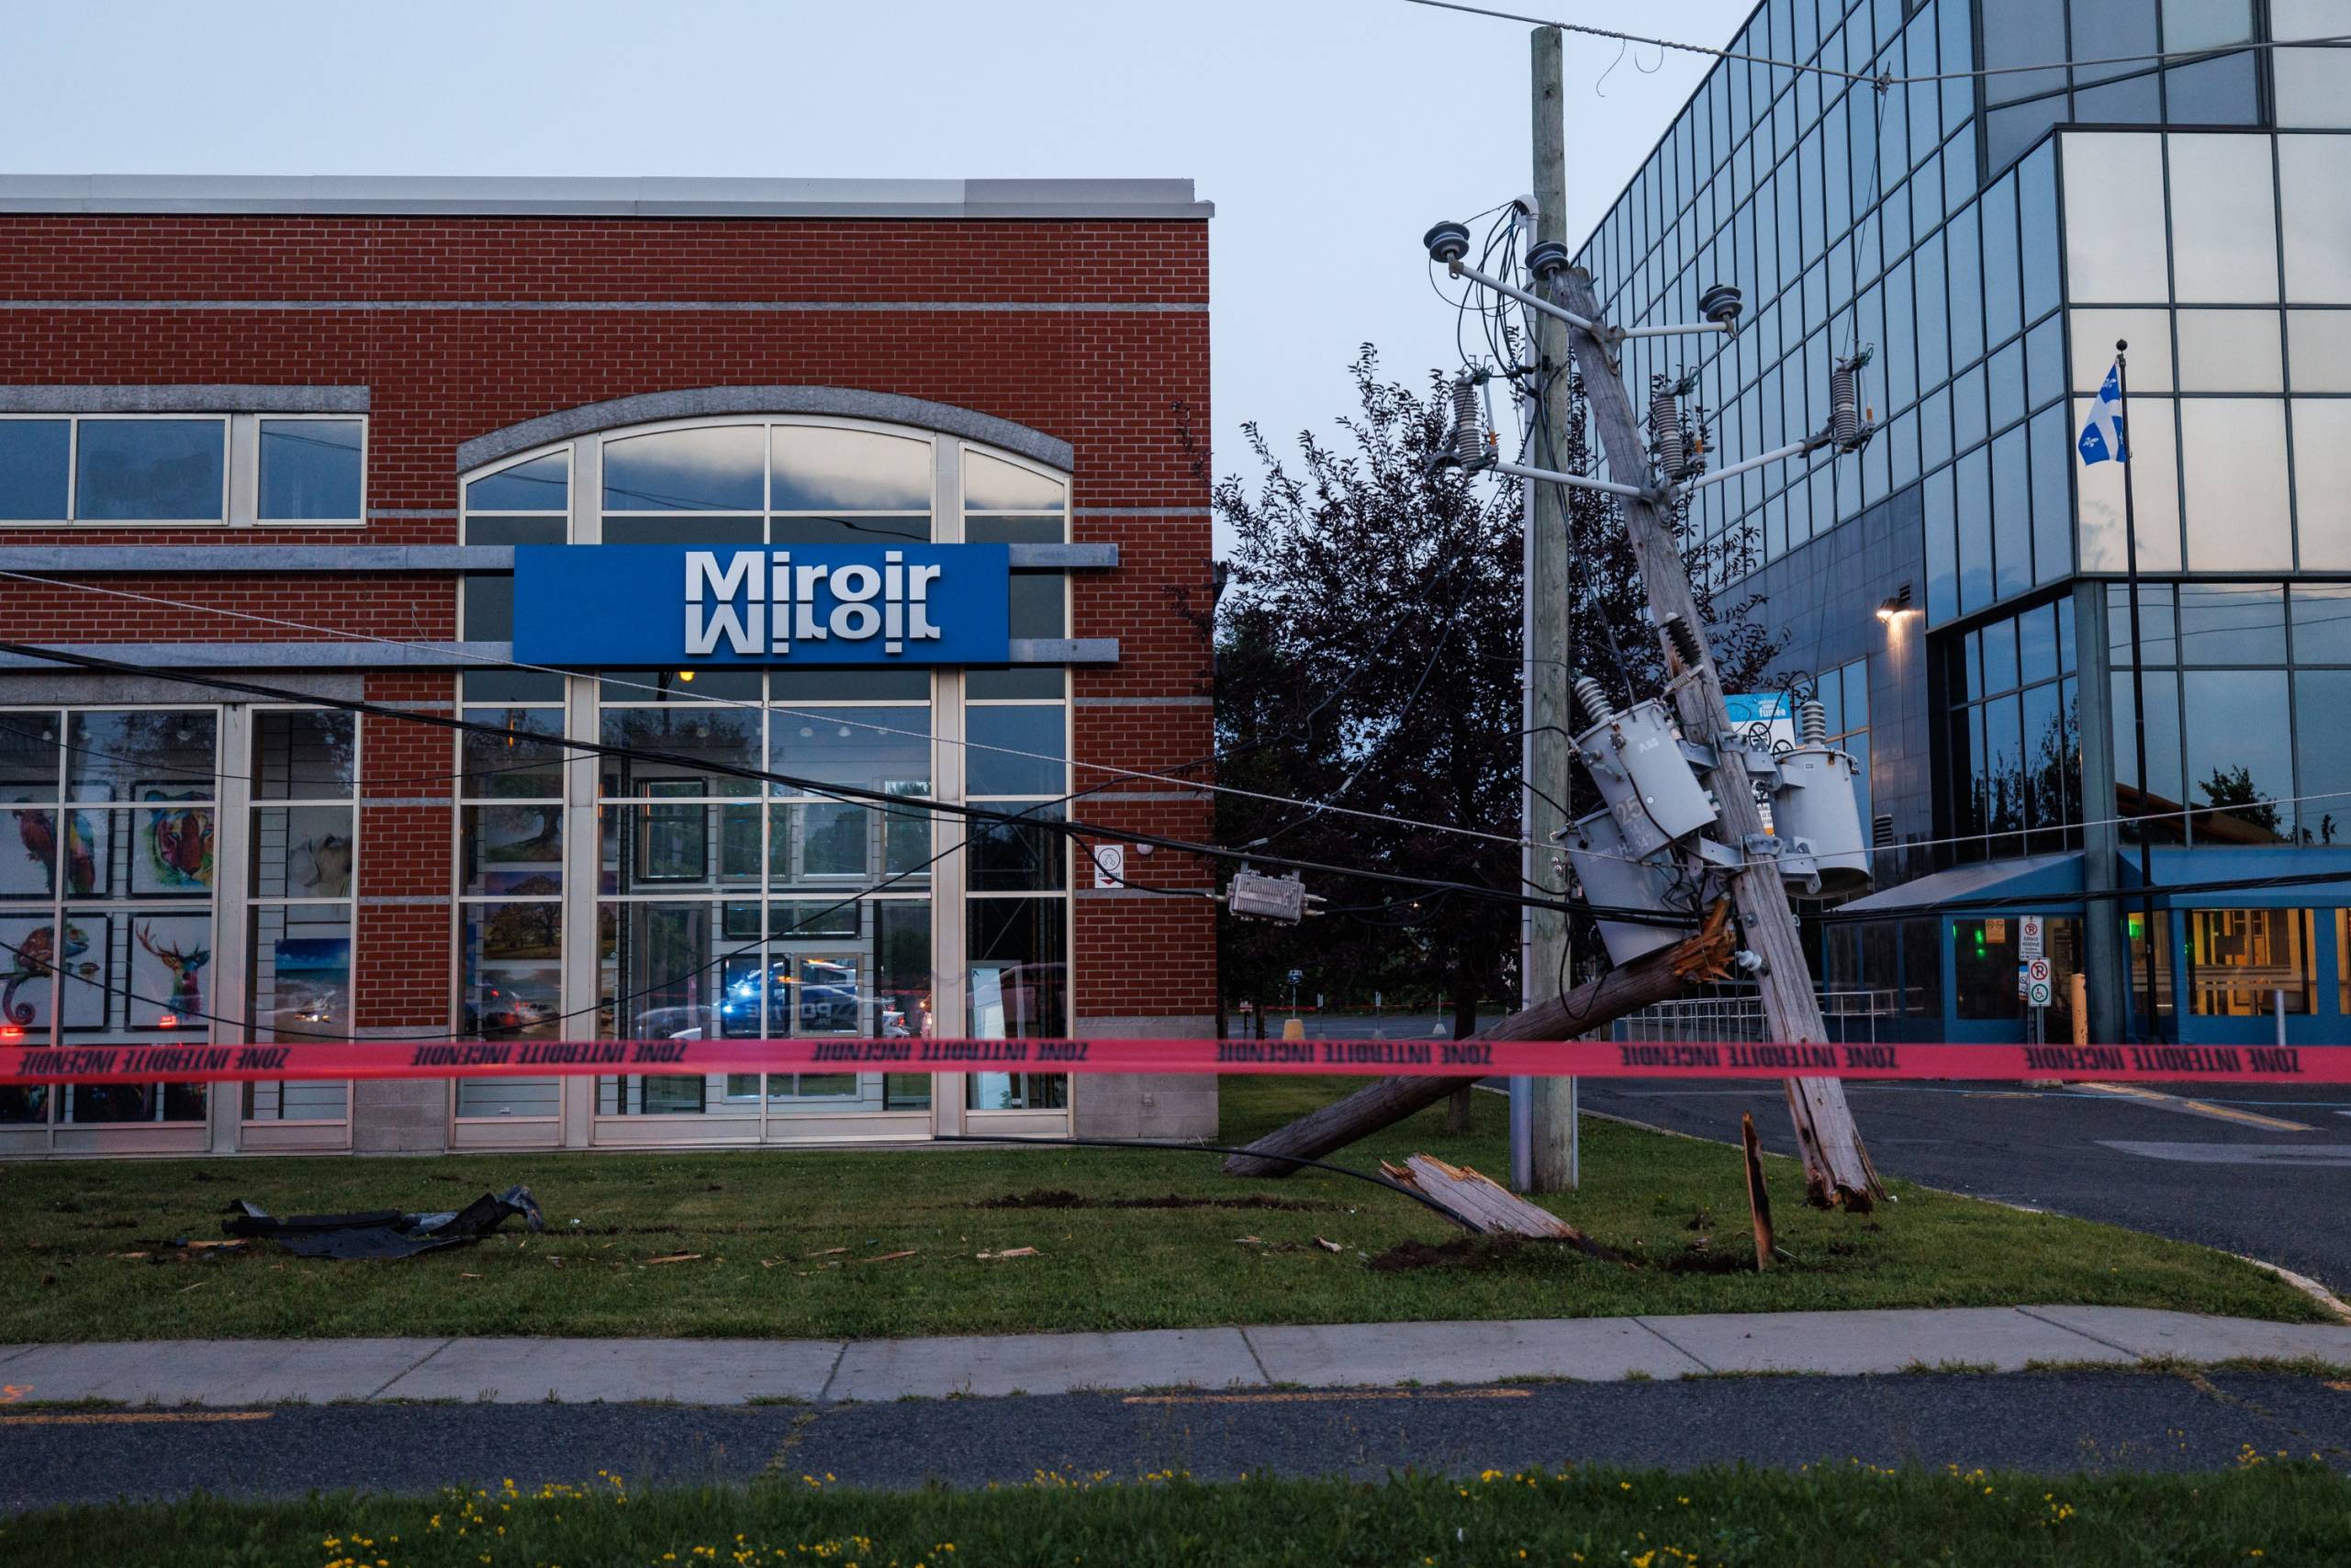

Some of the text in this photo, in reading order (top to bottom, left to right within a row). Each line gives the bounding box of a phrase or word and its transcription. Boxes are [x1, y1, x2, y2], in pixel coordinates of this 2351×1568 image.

[686, 551, 940, 601] Miroir
[1616, 794, 1644, 825] 25
[17, 1047, 290, 1075] ZONE INTERDITE INCENDIE
[413, 1044, 687, 1065] ZONE INTERDITE INCENDIE
[811, 1043, 1089, 1061] ZONE INTERDITE INCENDIE
[1216, 1043, 1494, 1065] ZONE INTERDITE INCENDIE
[1619, 1045, 1898, 1068] ZONE INTERDITE INCENDIE
[2024, 1047, 2302, 1072] ZONE INTERDITE INCENDIE
